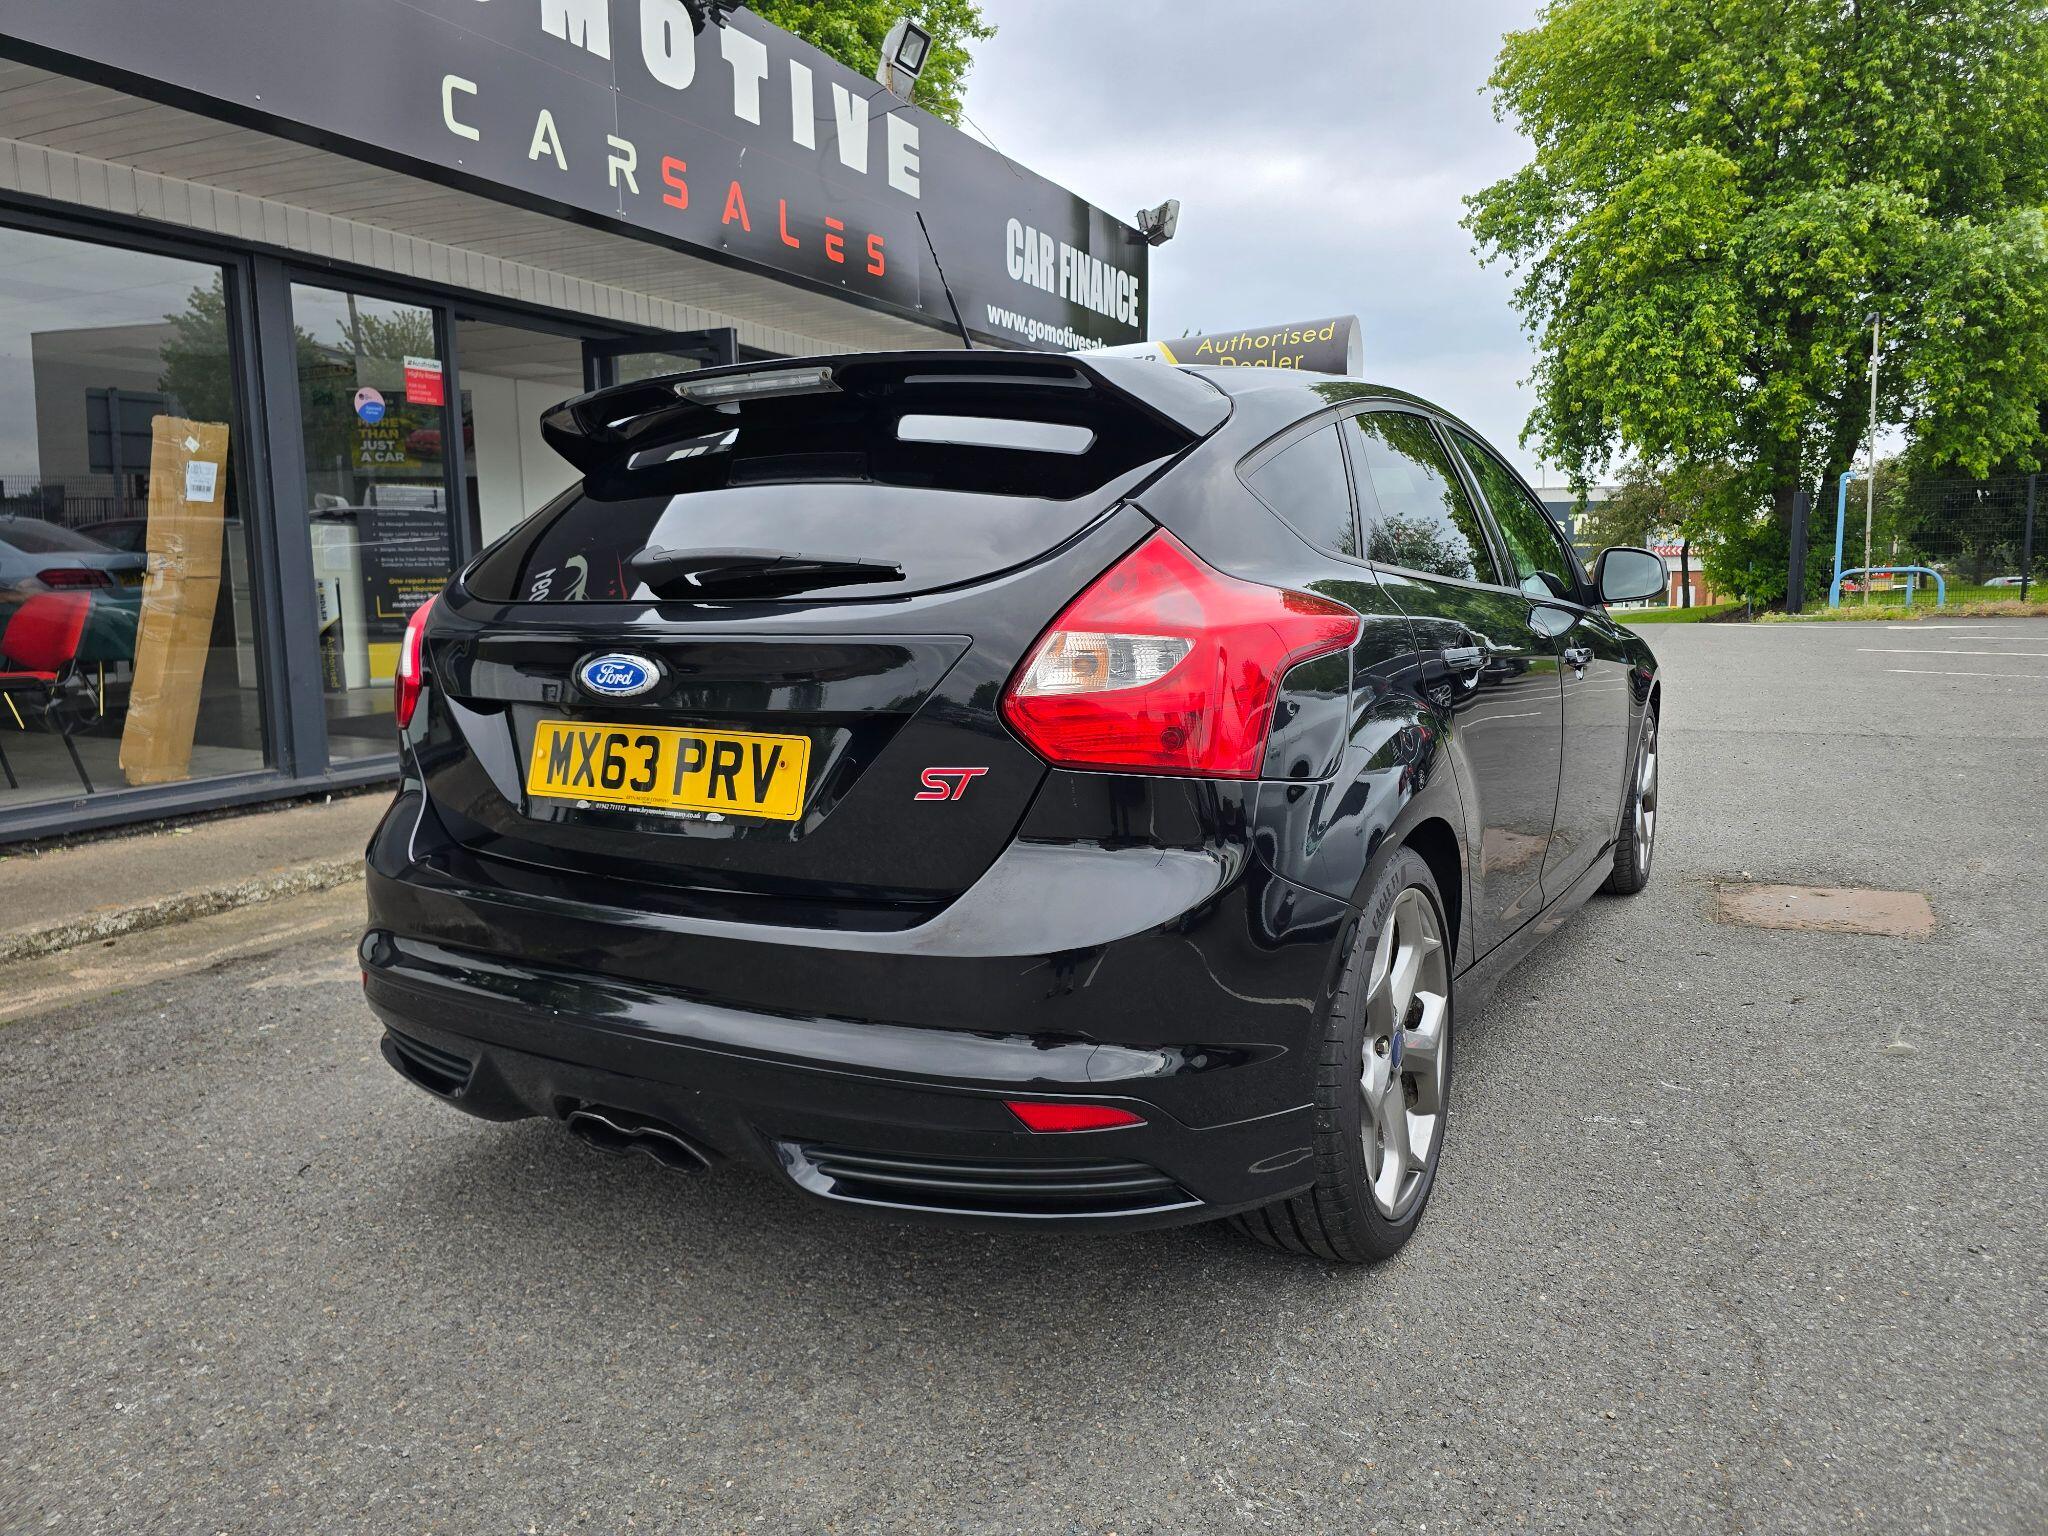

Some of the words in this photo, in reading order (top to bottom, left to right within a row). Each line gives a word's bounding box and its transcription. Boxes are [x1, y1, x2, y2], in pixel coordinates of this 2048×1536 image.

[540, 0, 920, 199] MOTIVE
[1006, 217, 1055, 294] CAR
[1059, 241, 1139, 328] FINANCE
[1194, 321, 1336, 356] Authorised
[358, 429, 399, 439] THAN
[360, 441, 395, 450] JUST
[361, 452, 372, 462] A
[375, 452, 405, 462] CAR
[597, 663, 634, 685] Ford
[547, 730, 660, 793] MX63
[672, 737, 783, 804] PRV
[914, 767, 989, 800] ST
